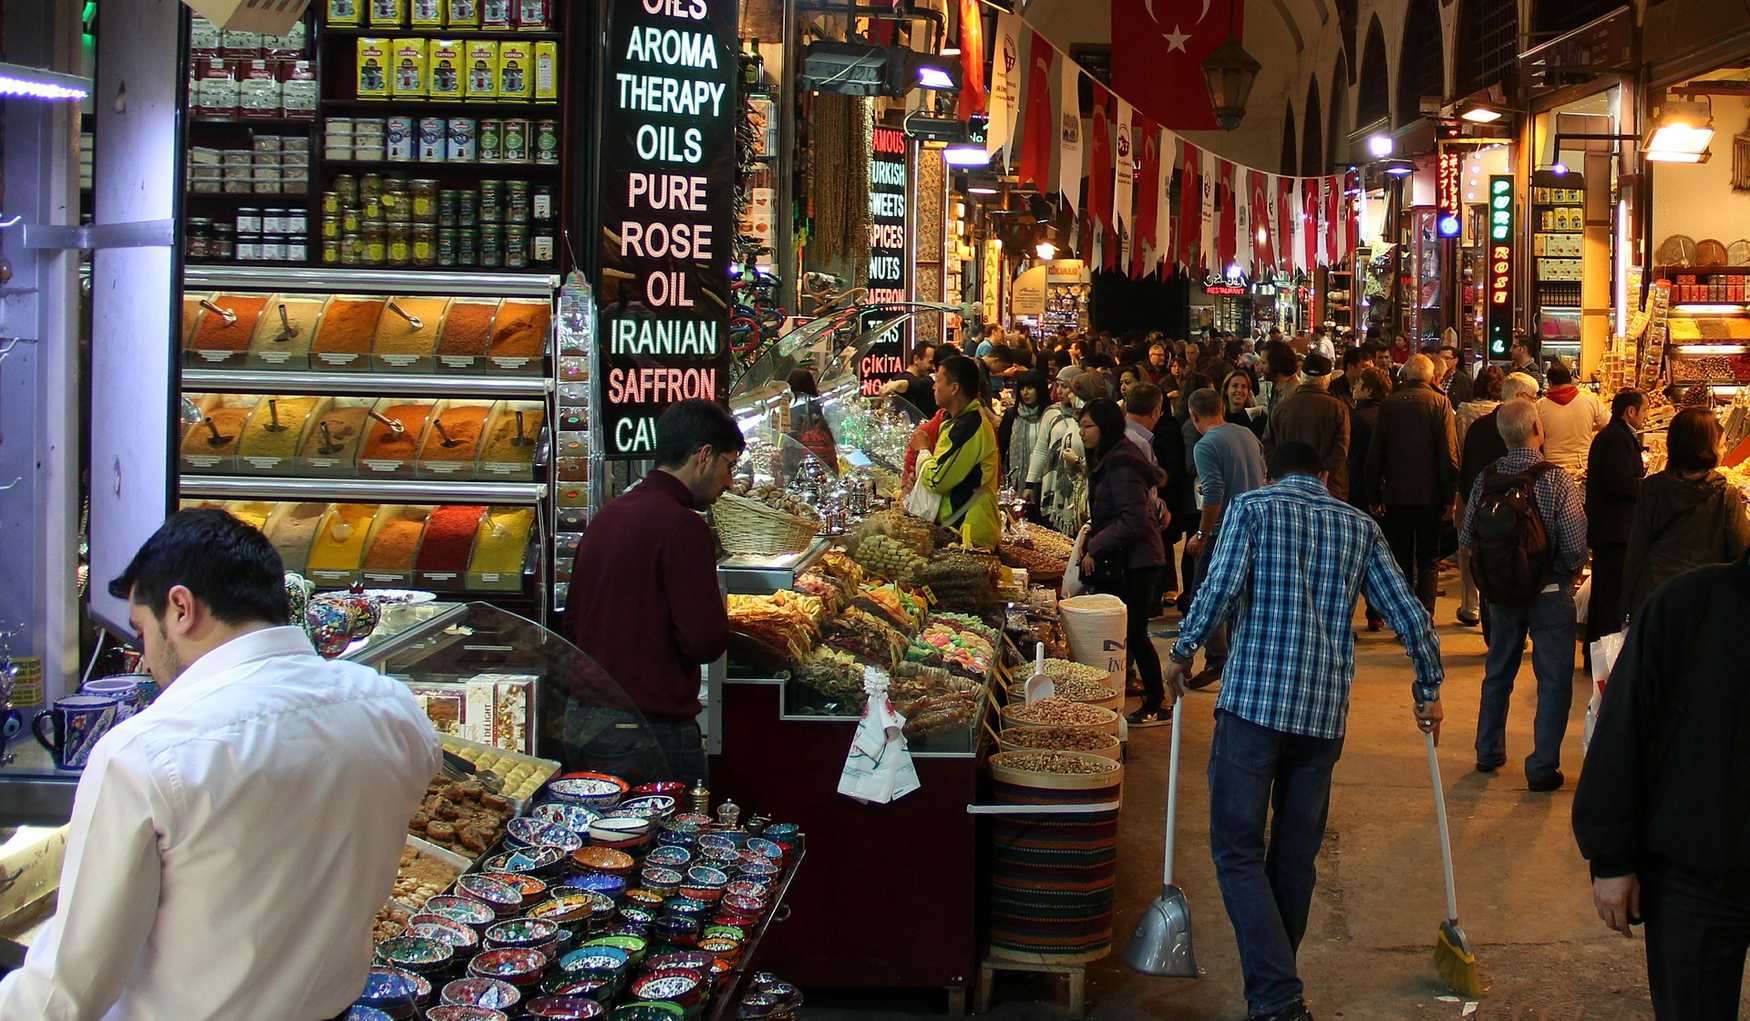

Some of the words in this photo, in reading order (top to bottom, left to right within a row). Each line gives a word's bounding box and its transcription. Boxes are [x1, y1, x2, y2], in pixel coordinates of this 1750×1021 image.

[626, 26, 718, 69] AROMA
[616, 73, 726, 117] THERAPY
[636, 124, 702, 163] OILS
[873, 129, 905, 154] AMOUS
[628, 172, 708, 211] PURE
[872, 192, 905, 217] WEETS
[621, 221, 713, 260] ROSE
[869, 256, 900, 280] NUTS
[646, 270, 694, 307] OIL
[610, 319, 717, 355] IRANIAN
[608, 367, 716, 404] SAFFRON
[484, 704, 492, 738] DELIGHT
